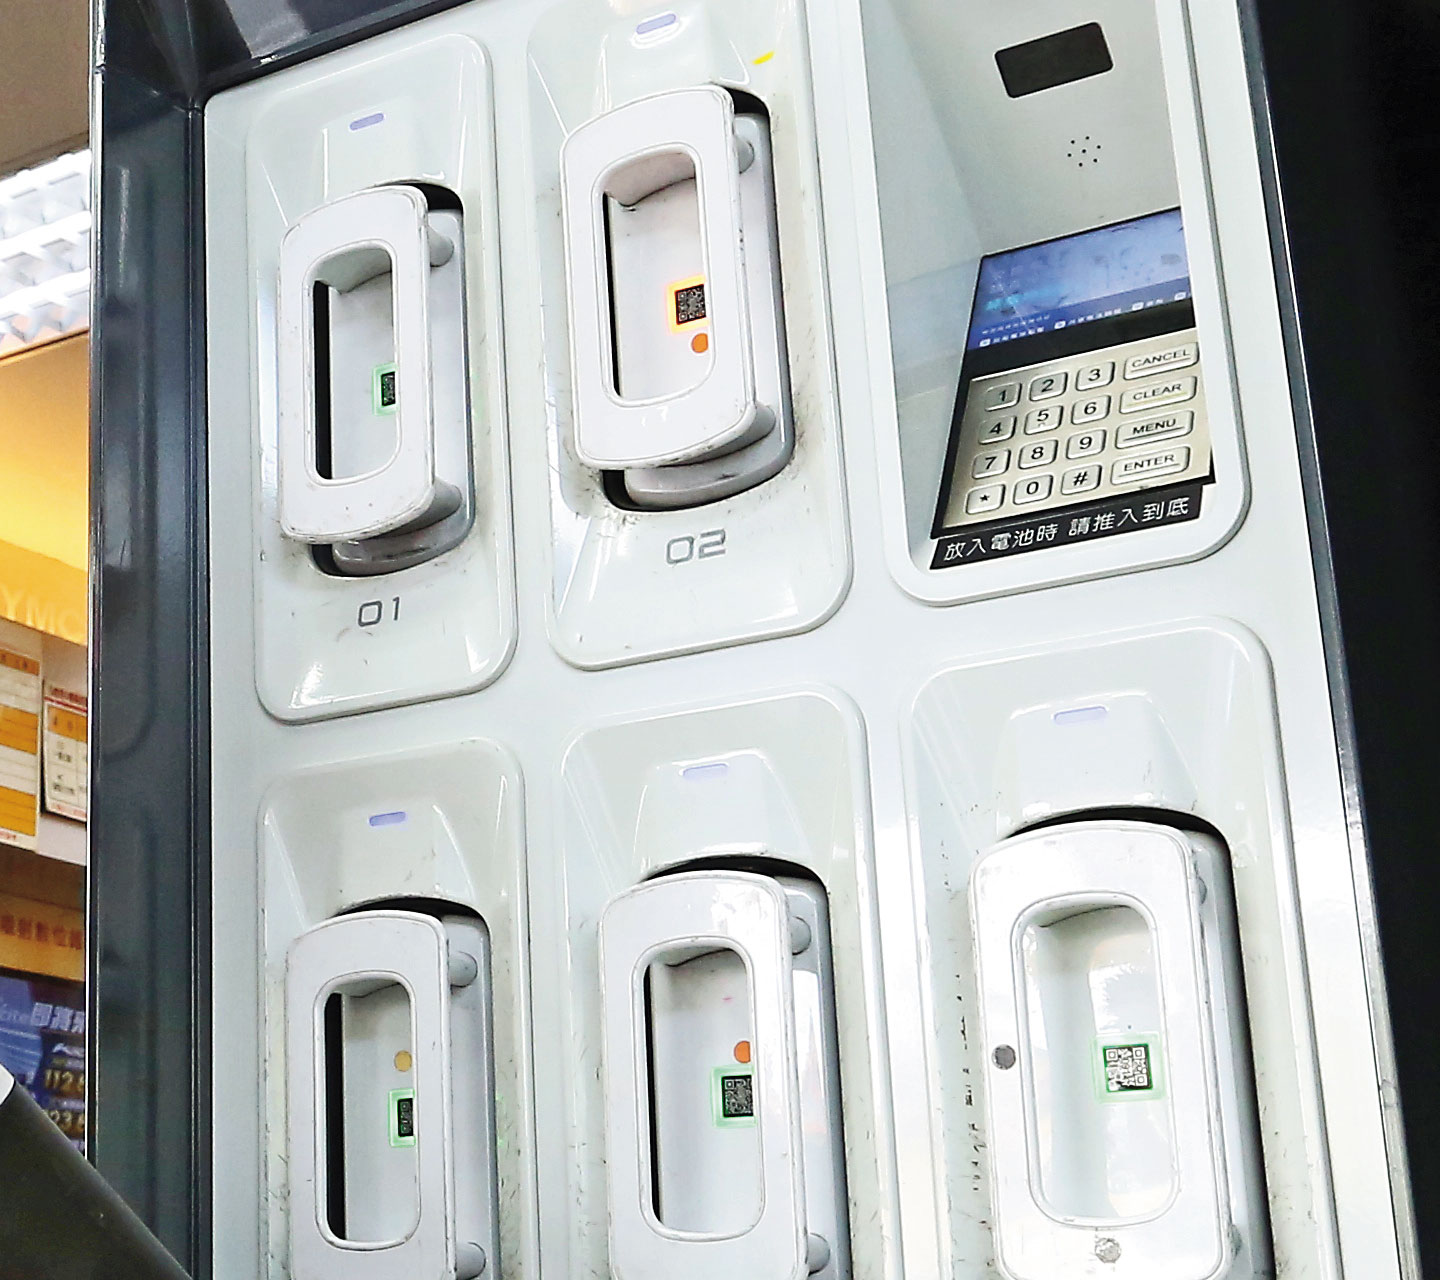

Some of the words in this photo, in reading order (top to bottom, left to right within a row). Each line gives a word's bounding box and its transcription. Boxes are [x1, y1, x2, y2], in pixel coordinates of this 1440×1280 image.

[1131, 348, 1190, 368] CANCEL
[1088, 368, 1101, 382] 3
[1041, 380, 1054, 393] 2
[1133, 383, 1182, 401] CLEAR
[1084, 402, 1097, 415] 6
[1037, 410, 1049, 422] 5
[990, 422, 1003, 435] 4
[1132, 419, 1177, 435] MENU
[1079, 436, 1092, 450] 9
[1031, 446, 1044, 460] 8
[985, 456, 997, 470] 7
[1124, 454, 1175, 472] ENTER
[1026, 481, 1039, 495] 0
[943, 523, 1059, 562] 放入電池時
[1068, 497, 1190, 536] 請推入到底
[666, 529, 728, 566] 02
[357, 597, 401, 627] 01
